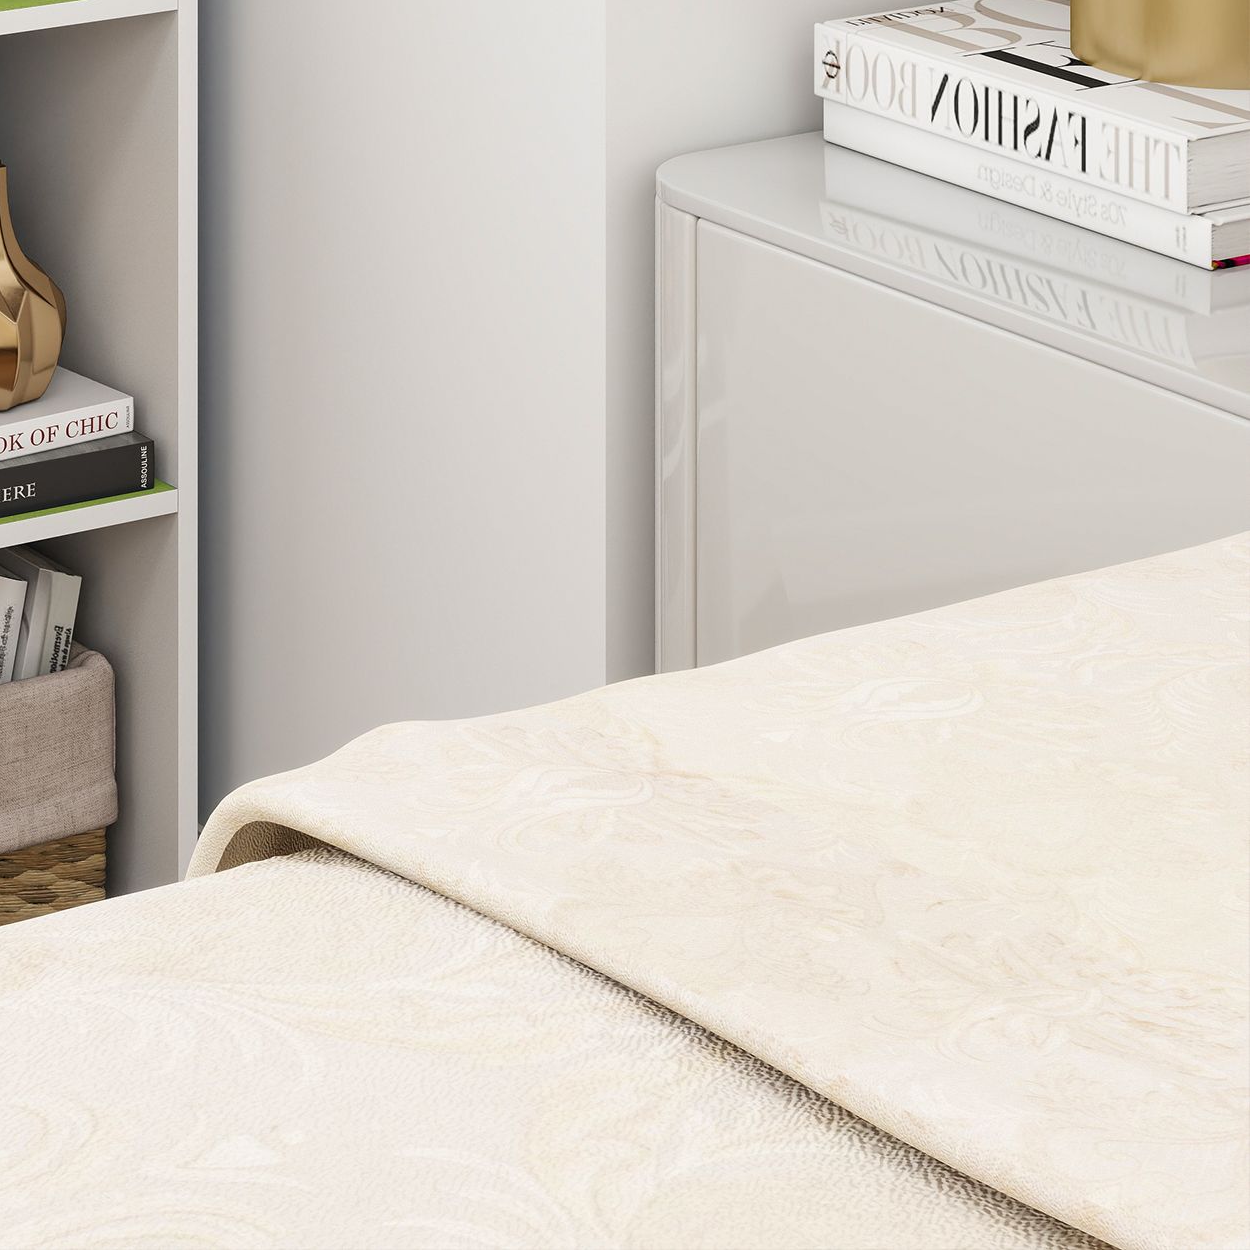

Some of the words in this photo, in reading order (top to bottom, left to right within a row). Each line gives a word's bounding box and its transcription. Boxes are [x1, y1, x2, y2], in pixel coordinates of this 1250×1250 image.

[30, 425, 60, 447] OF
[65, 411, 120, 439] CHIC
[140, 445, 148, 488] ASSOULINE
